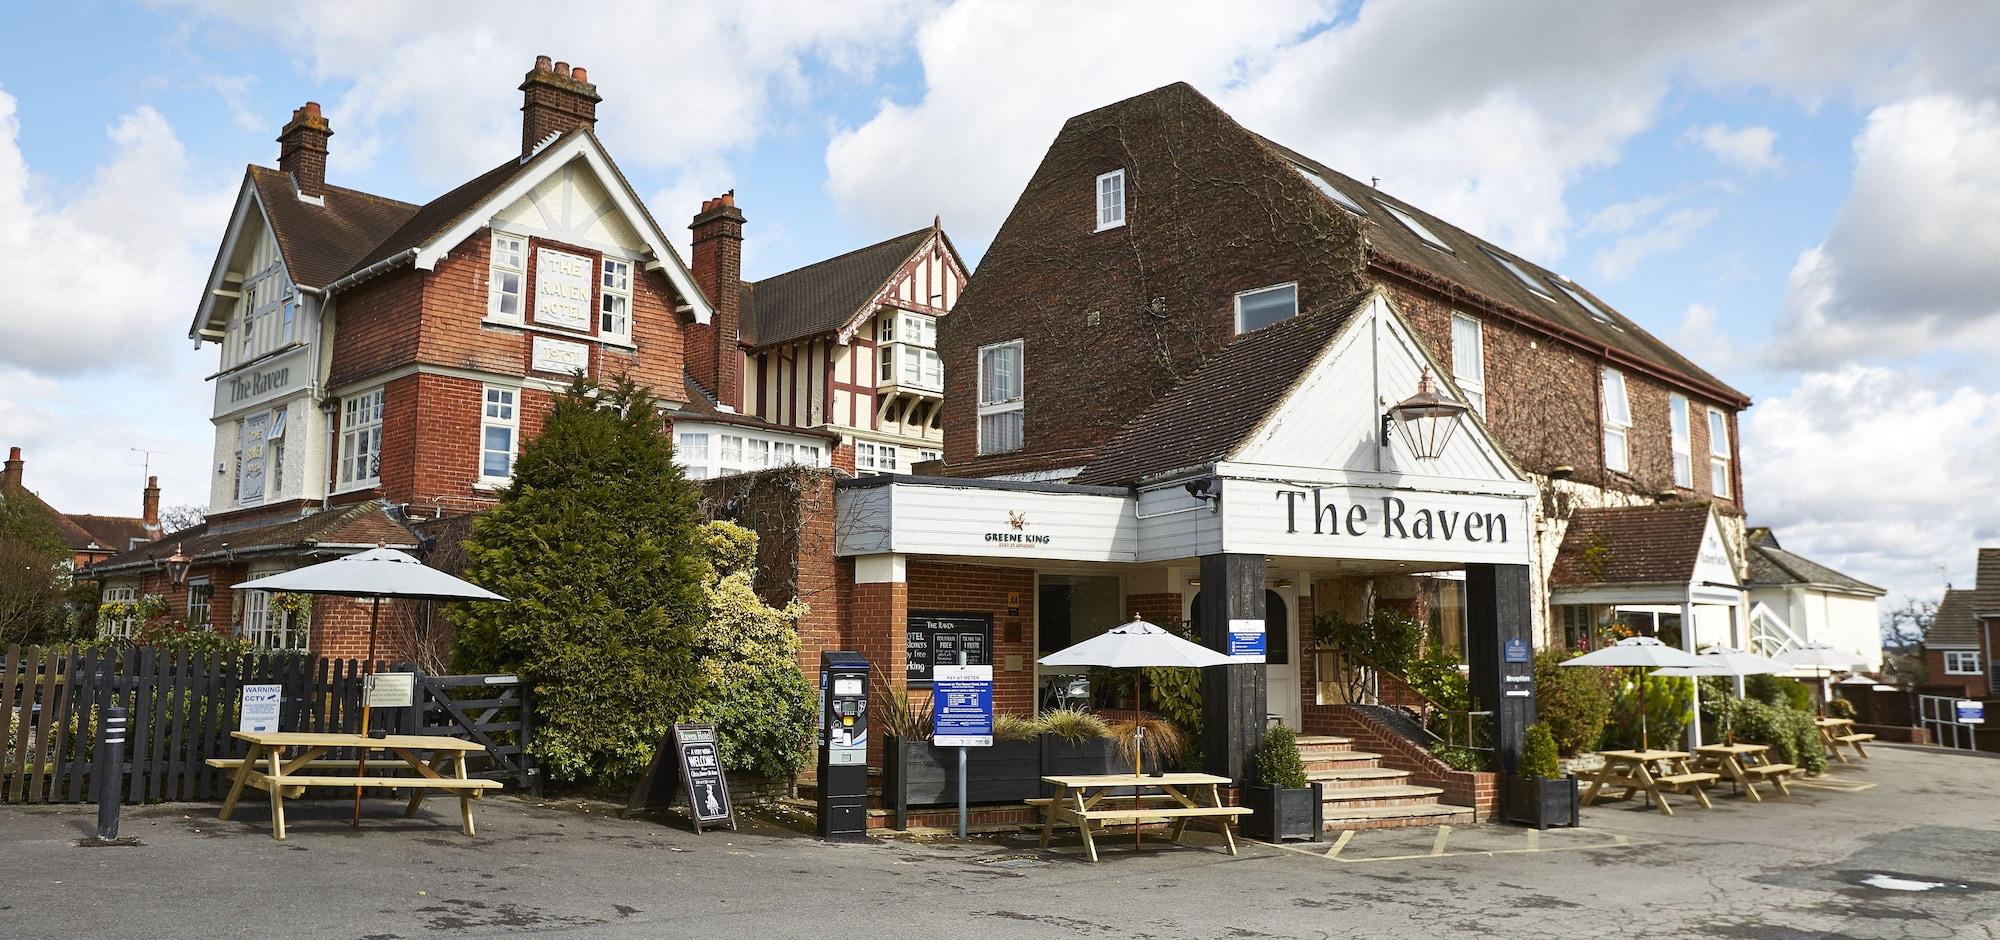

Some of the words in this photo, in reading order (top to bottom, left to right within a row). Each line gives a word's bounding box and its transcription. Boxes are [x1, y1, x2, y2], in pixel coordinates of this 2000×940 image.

[549, 259, 582, 277] THE
[540, 279, 588, 303] RAVEN
[540, 302, 586, 321] HOTEL
[230, 375, 250, 403] The
[253, 366, 289, 396] Raven
[1276, 488, 1368, 537] The
[1381, 496, 1509, 544] Raven
[985, 533, 1023, 543] GREENE
[1025, 534, 1050, 545] KING
[926, 621, 937, 629] THE
[907, 632, 924, 641] OTEL
[907, 641, 927, 649] stomers
[907, 661, 925, 673] rking
[1506, 675, 1530, 683] Reception
[680, 731, 697, 741] Raven
[697, 730, 712, 740] Hotel
[688, 755, 715, 767] WELCOME
